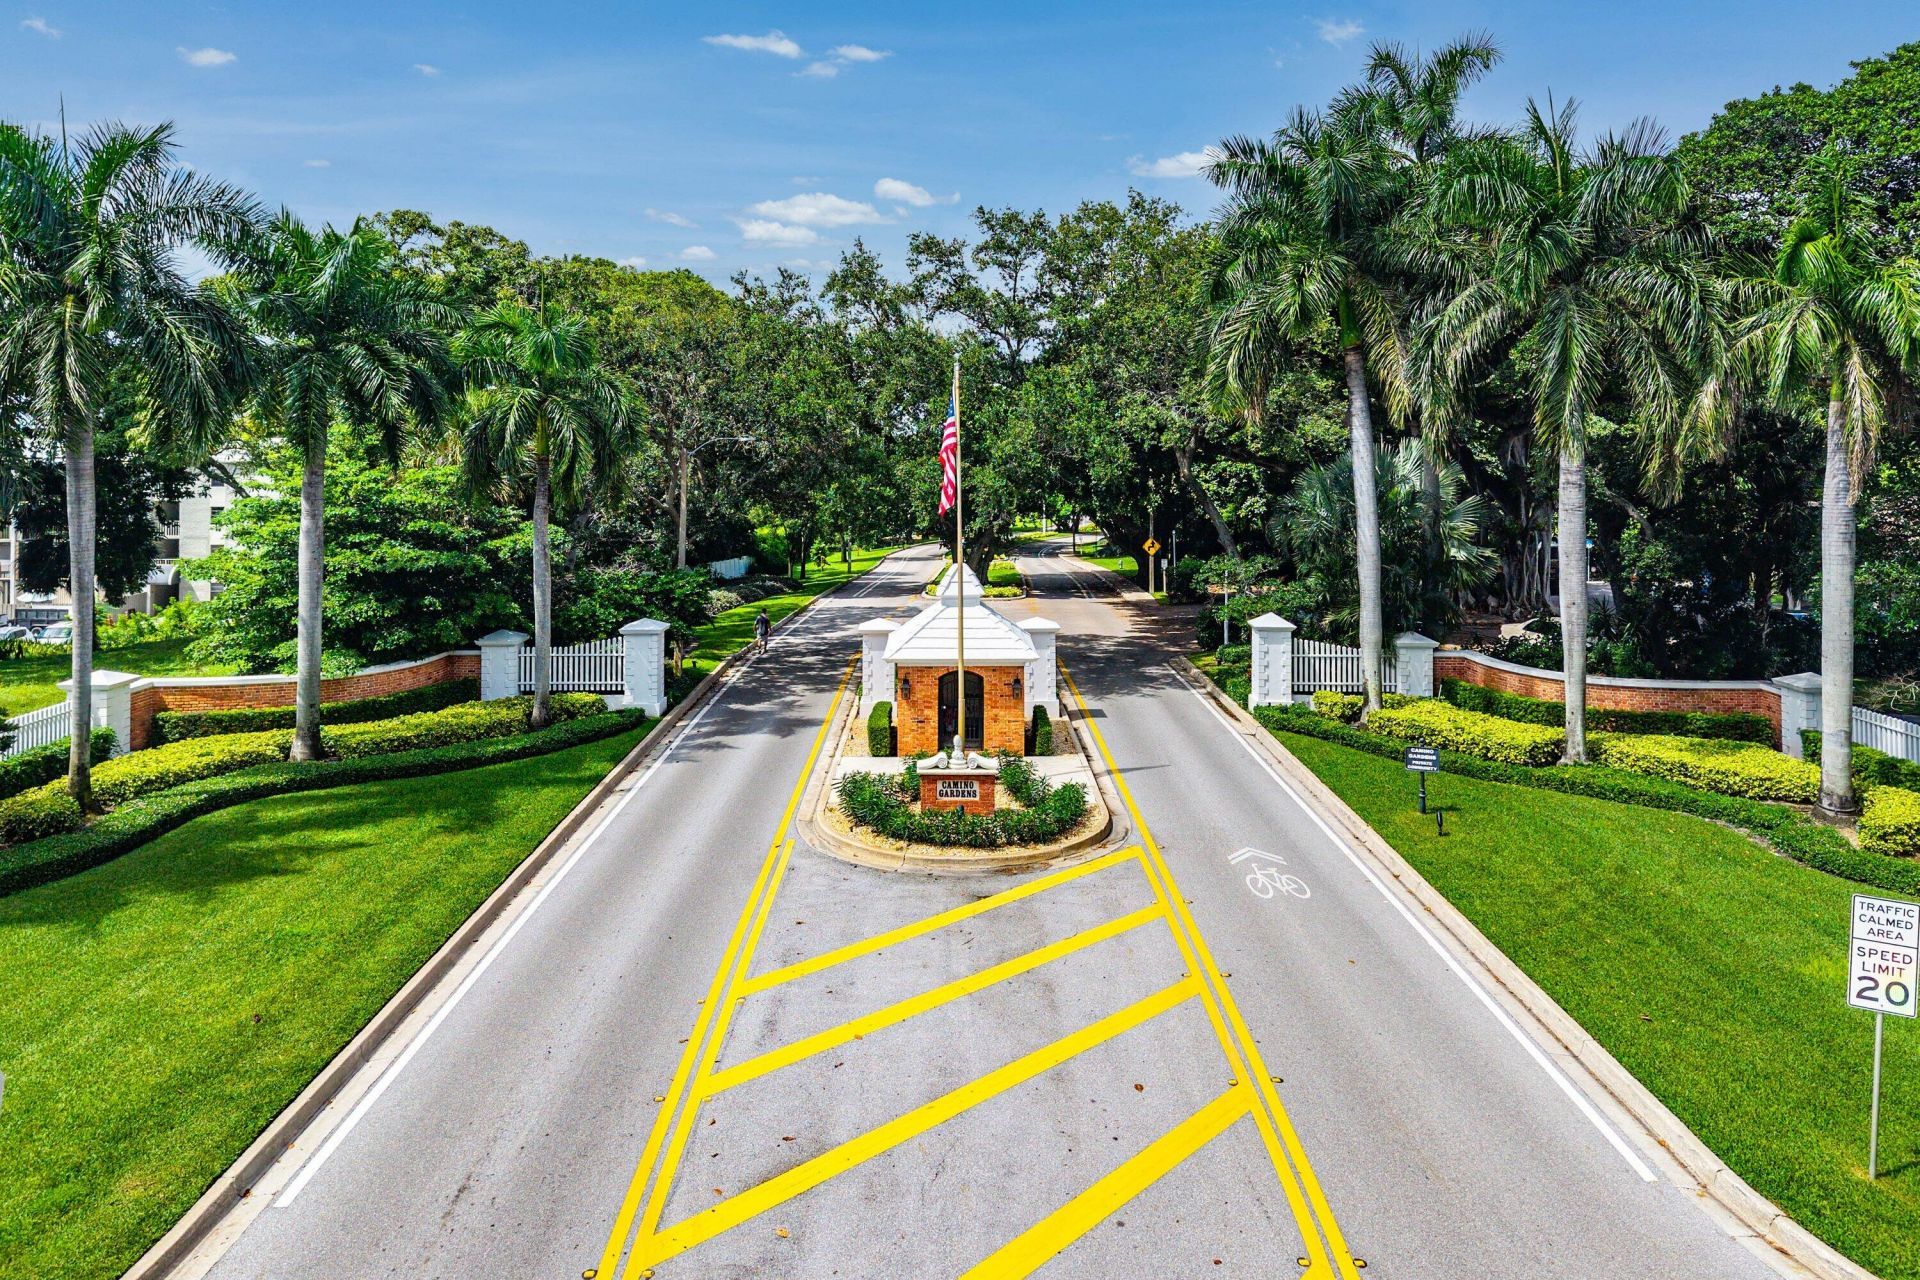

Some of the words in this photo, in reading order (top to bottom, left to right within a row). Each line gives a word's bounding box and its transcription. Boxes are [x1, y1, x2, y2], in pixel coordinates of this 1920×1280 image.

[939, 789, 977, 798] GARDENS
[942, 781, 974, 789] CAMINO
[1860, 901, 1915, 918] TRAFFIC
[1859, 913, 1913, 930] CALMED
[1867, 927, 1904, 941] AREA
[1857, 946, 1913, 965] SPEED
[1862, 961, 1906, 978] LIMIT
[1856, 975, 1909, 1007] 20
